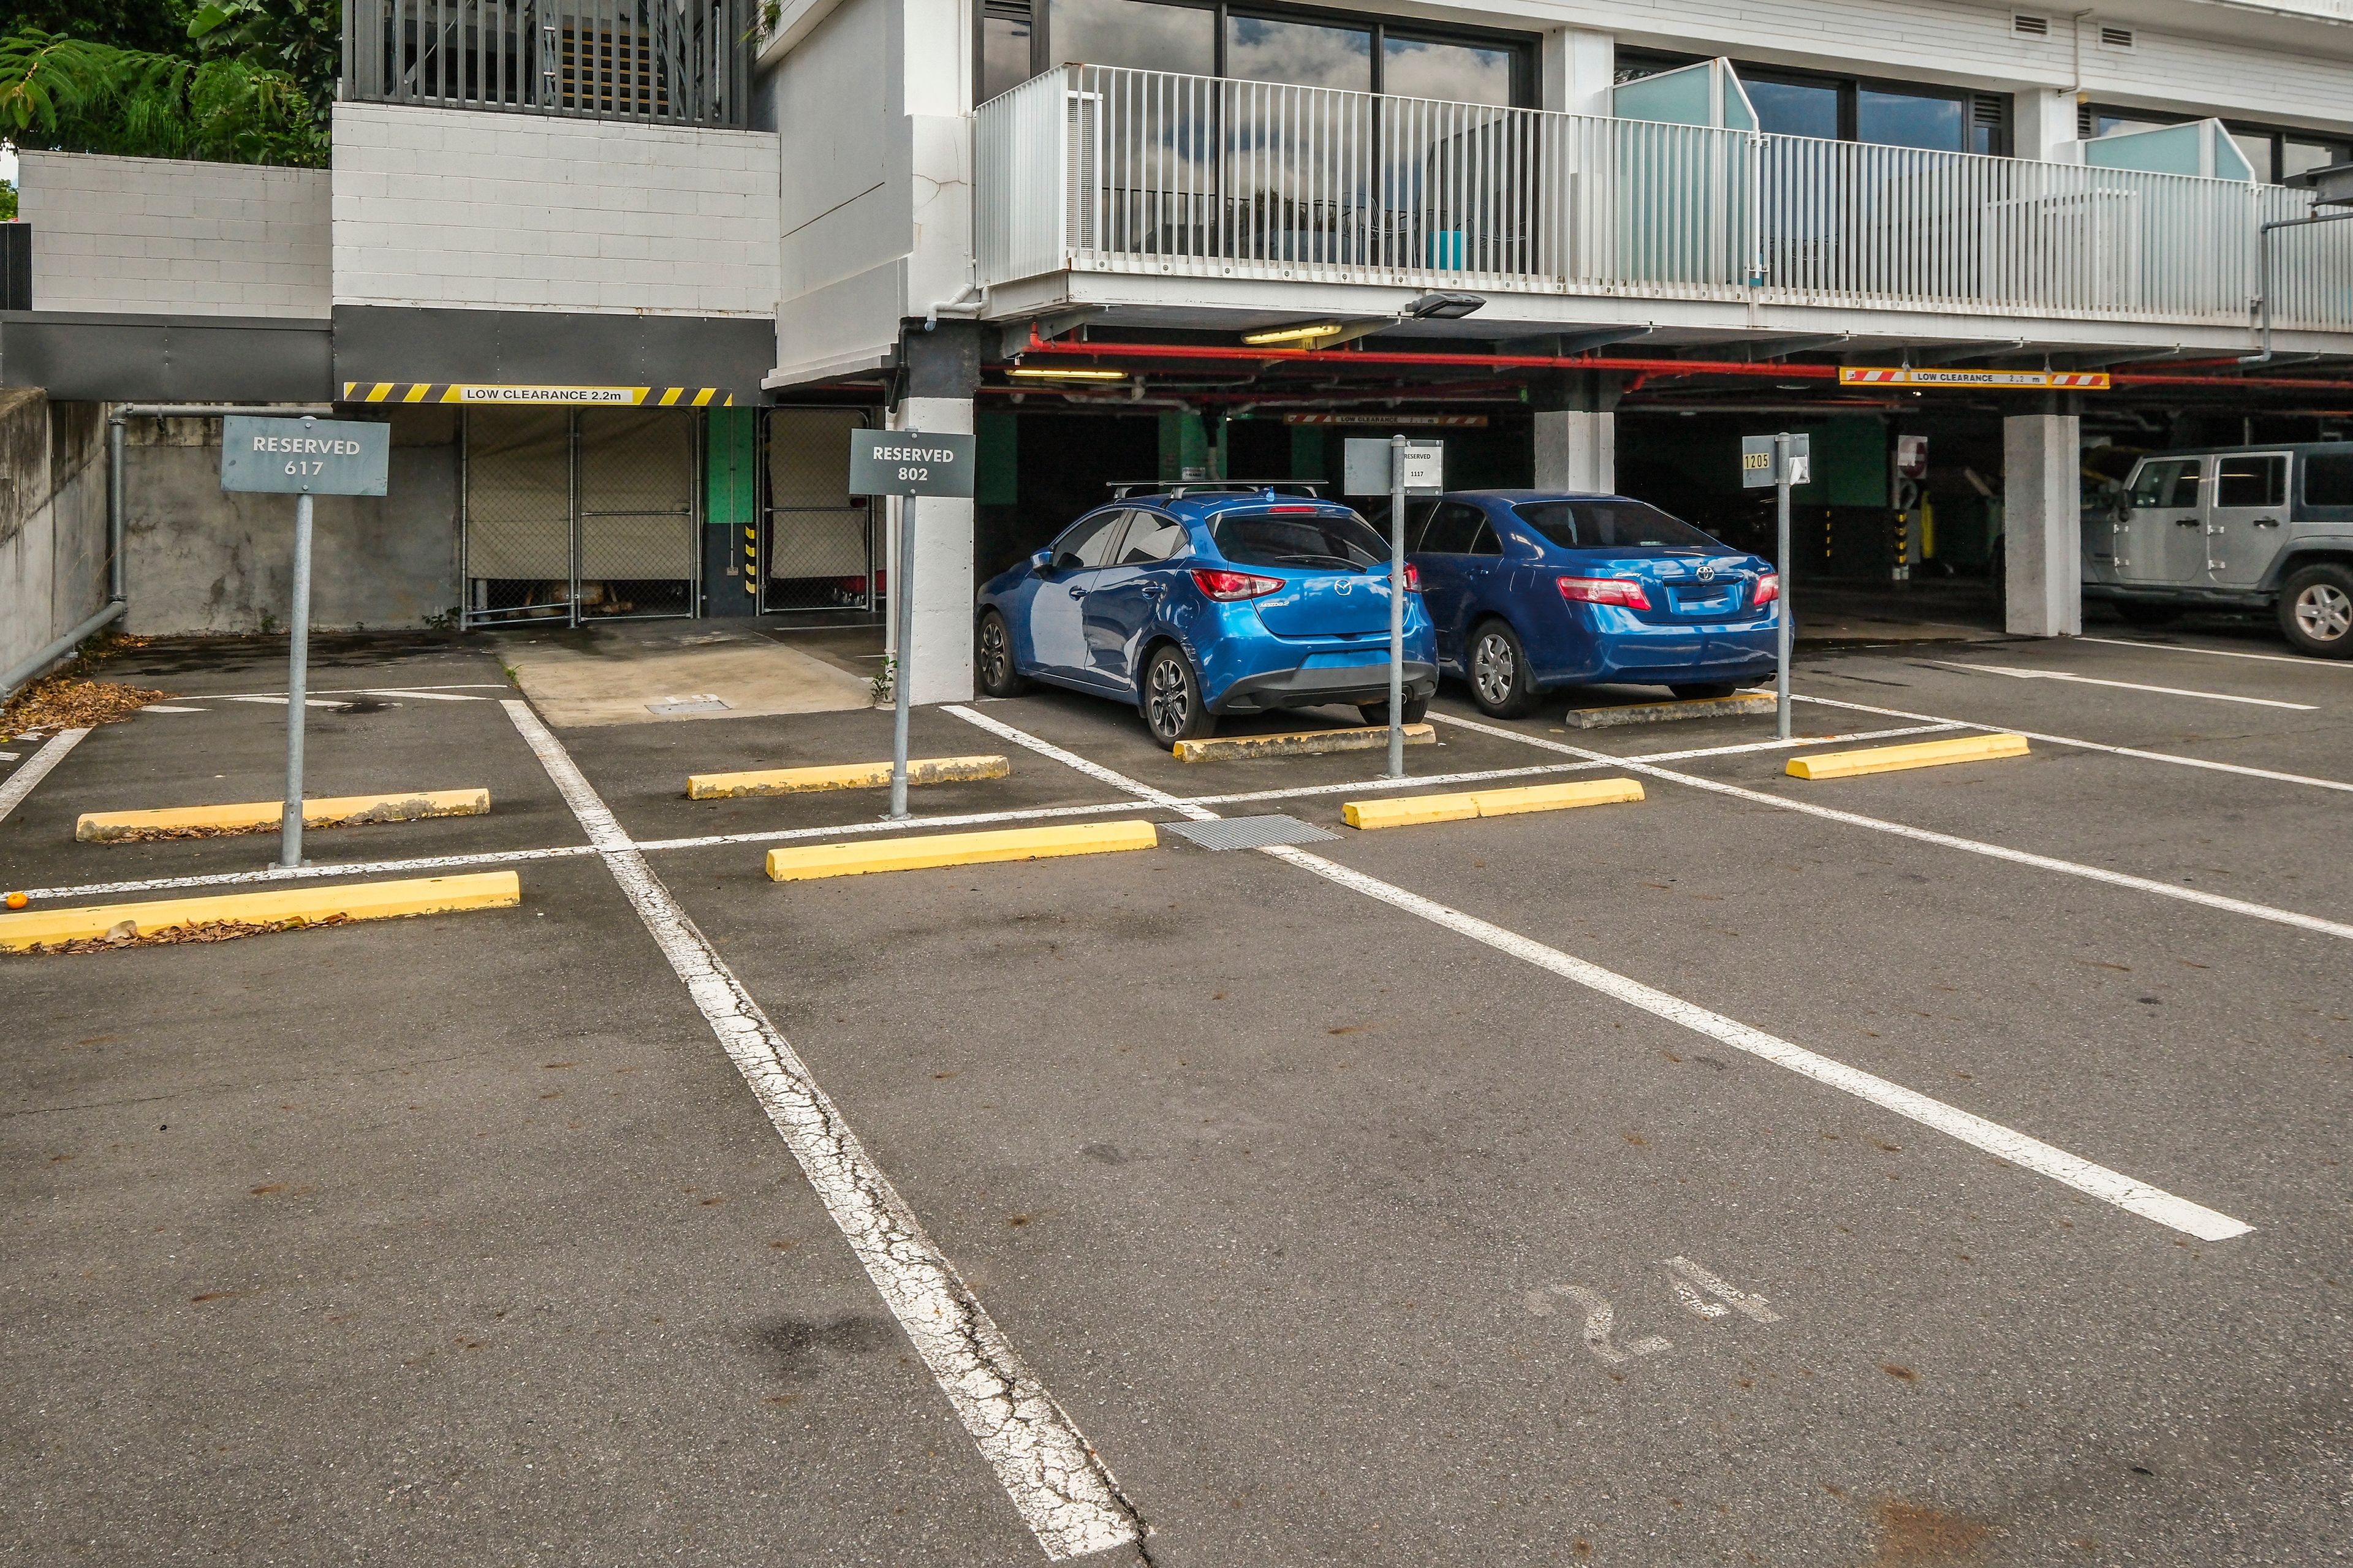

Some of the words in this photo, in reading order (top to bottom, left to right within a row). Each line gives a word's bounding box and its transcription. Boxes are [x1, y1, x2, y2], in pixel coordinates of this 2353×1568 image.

[467, 389, 499, 399] LOW
[503, 390, 588, 400] CLEARANCE
[591, 392, 621, 400] 2.2m
[253, 436, 360, 455] RESERVED
[873, 446, 954, 463] RESERVED
[1745, 454, 1768, 468] 1205
[284, 461, 324, 475] 617
[898, 467, 928, 481] 802
[1523, 1255, 1783, 1363] 24
